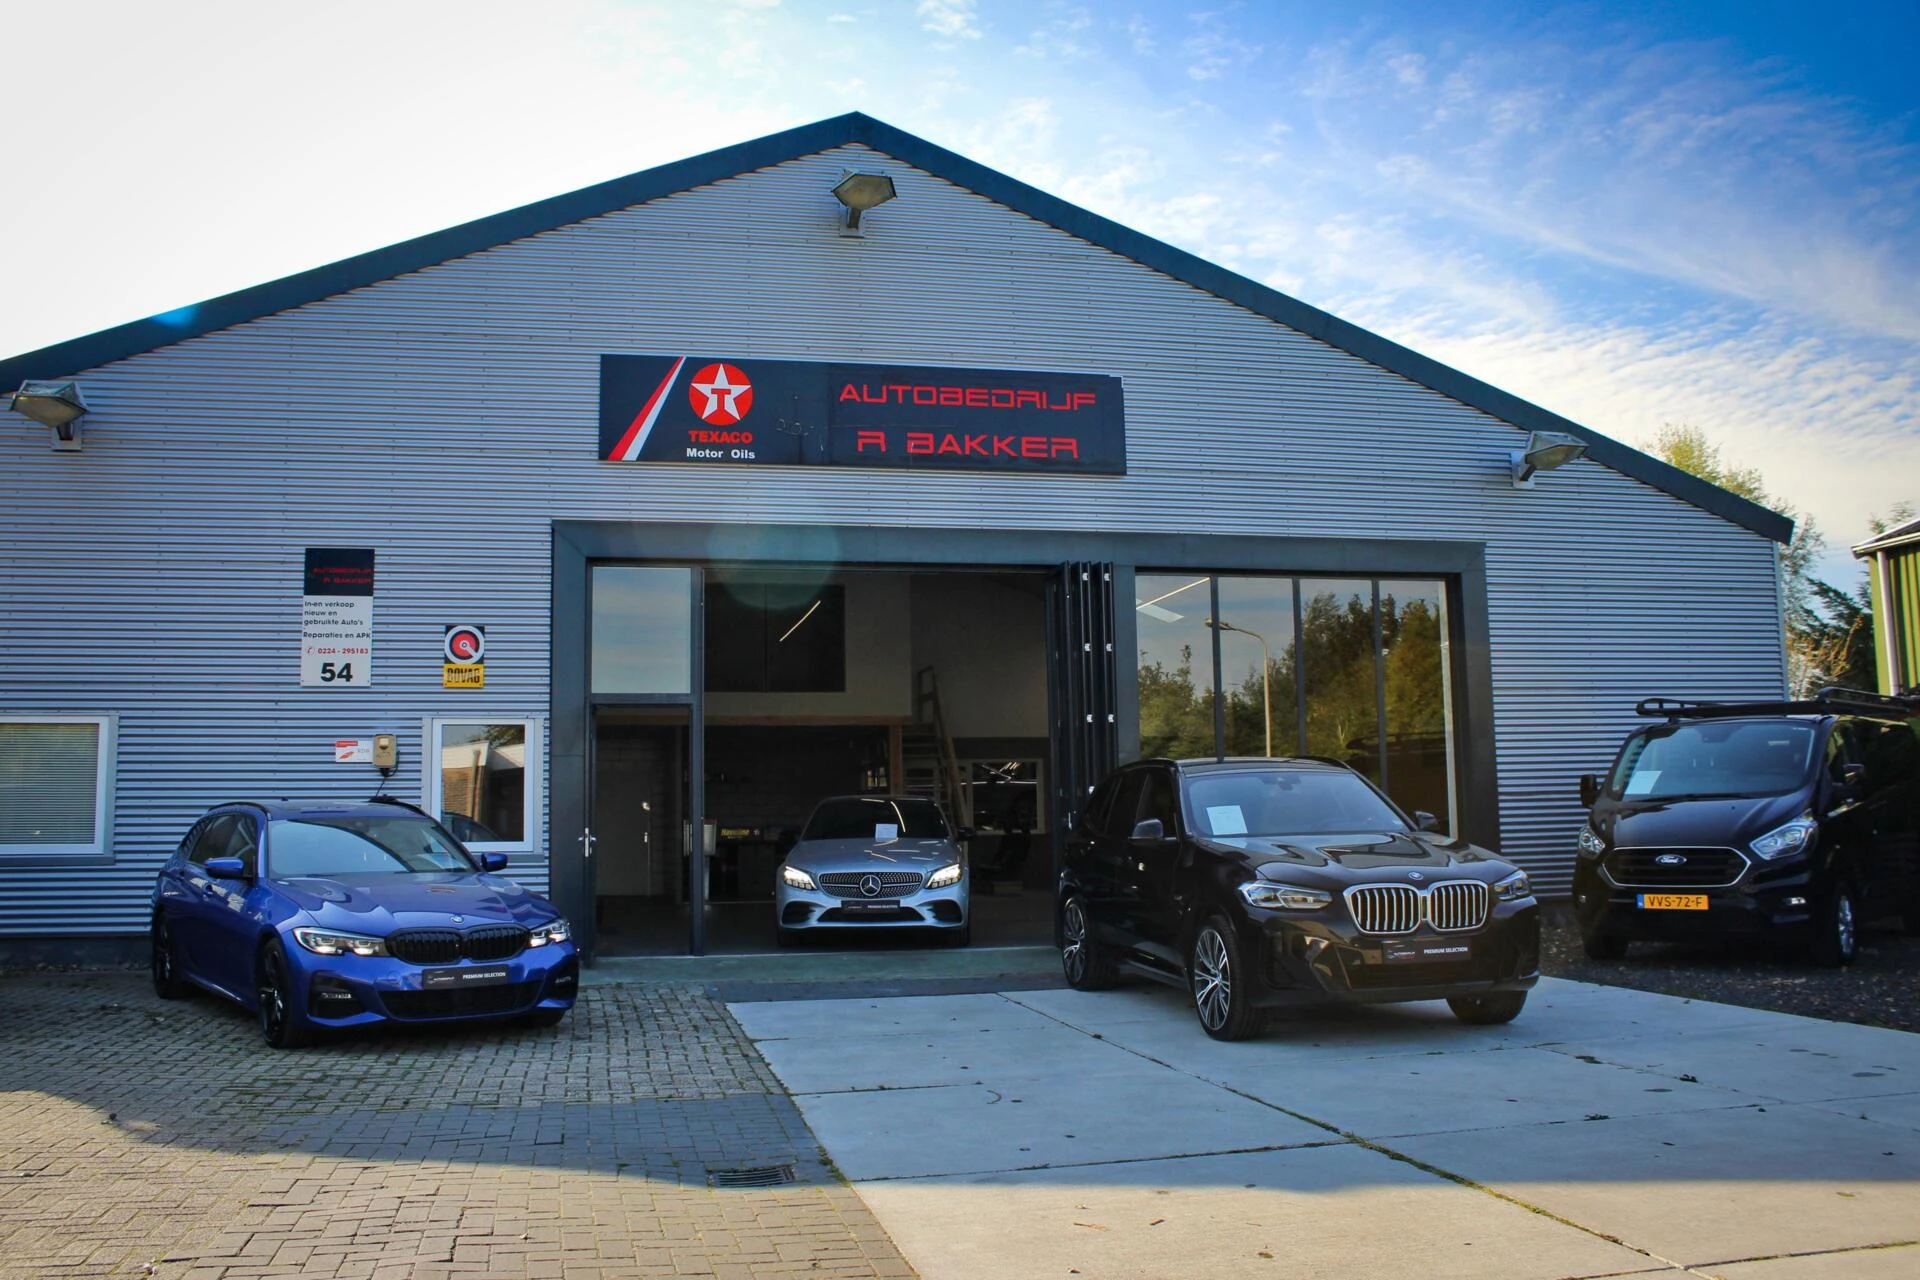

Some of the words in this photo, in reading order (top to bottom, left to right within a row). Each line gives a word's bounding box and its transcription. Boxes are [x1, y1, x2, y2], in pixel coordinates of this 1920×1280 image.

[839, 383, 1096, 411] AUTOBEDRIJF
[688, 430, 753, 444] TEXACO
[857, 431, 887, 453] R
[907, 432, 1080, 459] BAKKER
[686, 447, 724, 458] Motor
[731, 449, 756, 459] Oils
[325, 601, 355, 609] verkoop
[320, 662, 353, 682] 54
[447, 667, 480, 683] BOVAG
[1648, 895, 1703, 908] VVS-72-F
